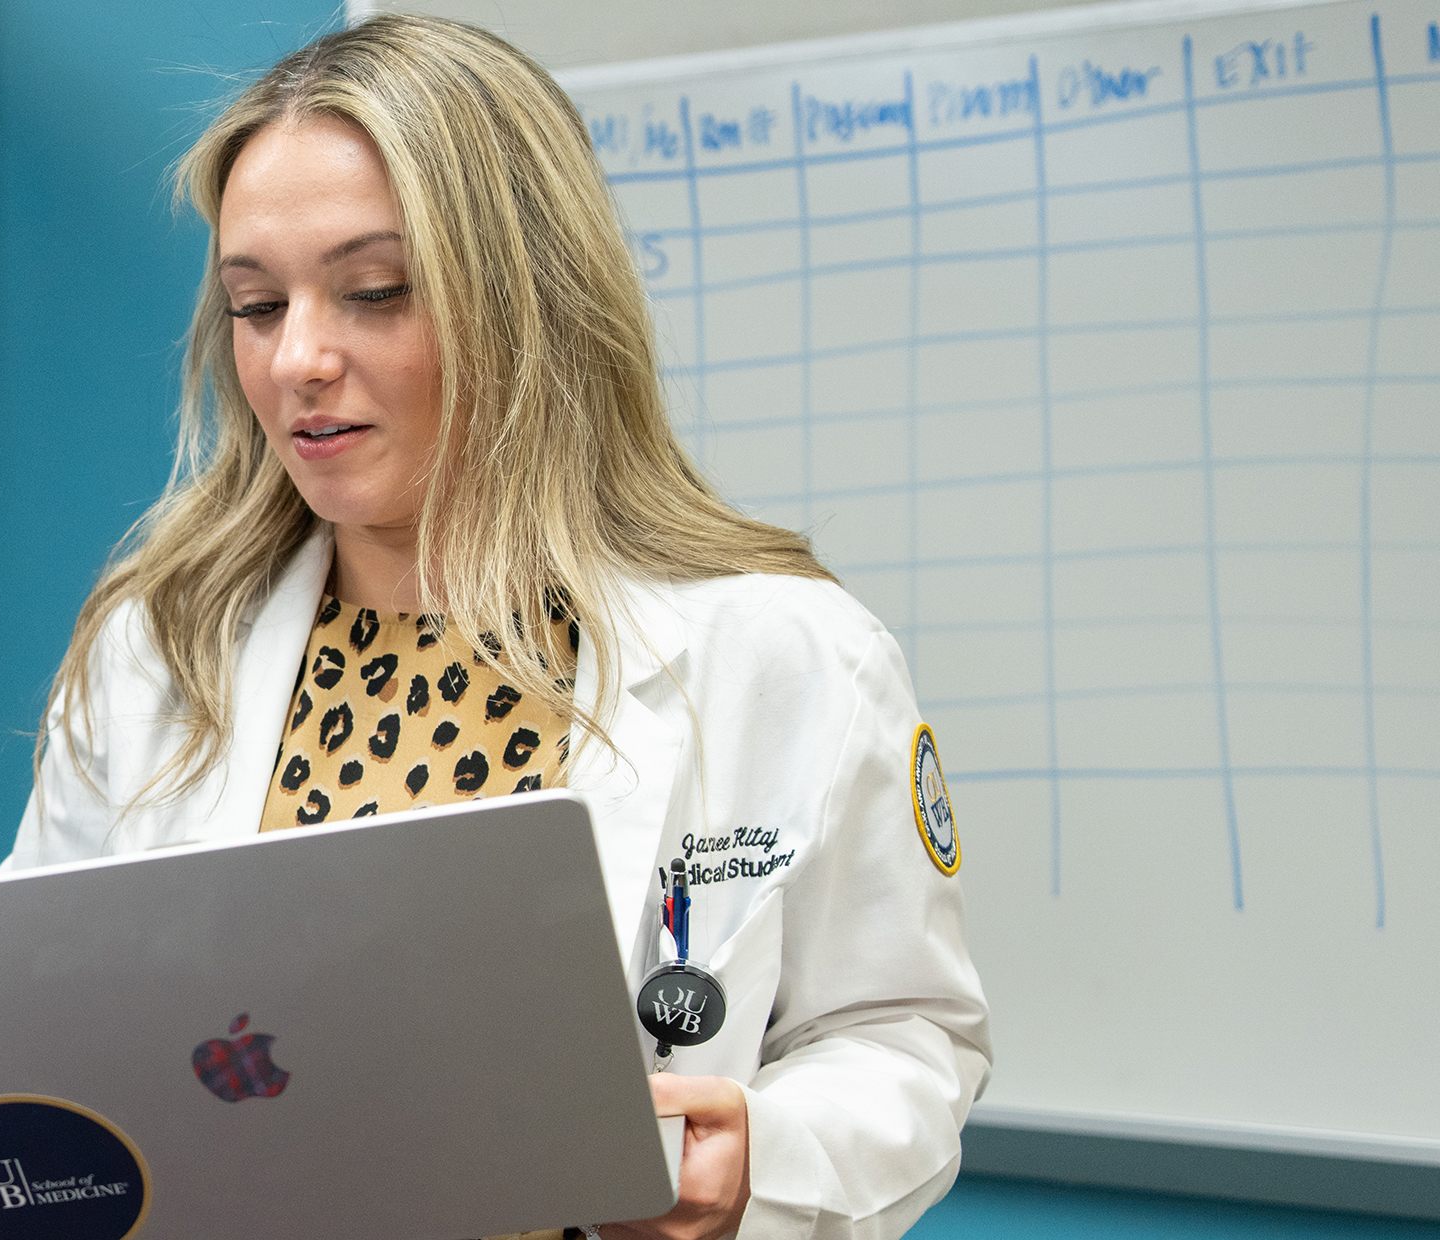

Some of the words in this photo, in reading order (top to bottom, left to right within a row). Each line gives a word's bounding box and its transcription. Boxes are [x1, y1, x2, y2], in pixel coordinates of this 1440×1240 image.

[727, 848, 796, 879] Student
[652, 1000, 702, 1034] WB
[31, 1176, 76, 1192] School
[78, 1173, 95, 1187] of
